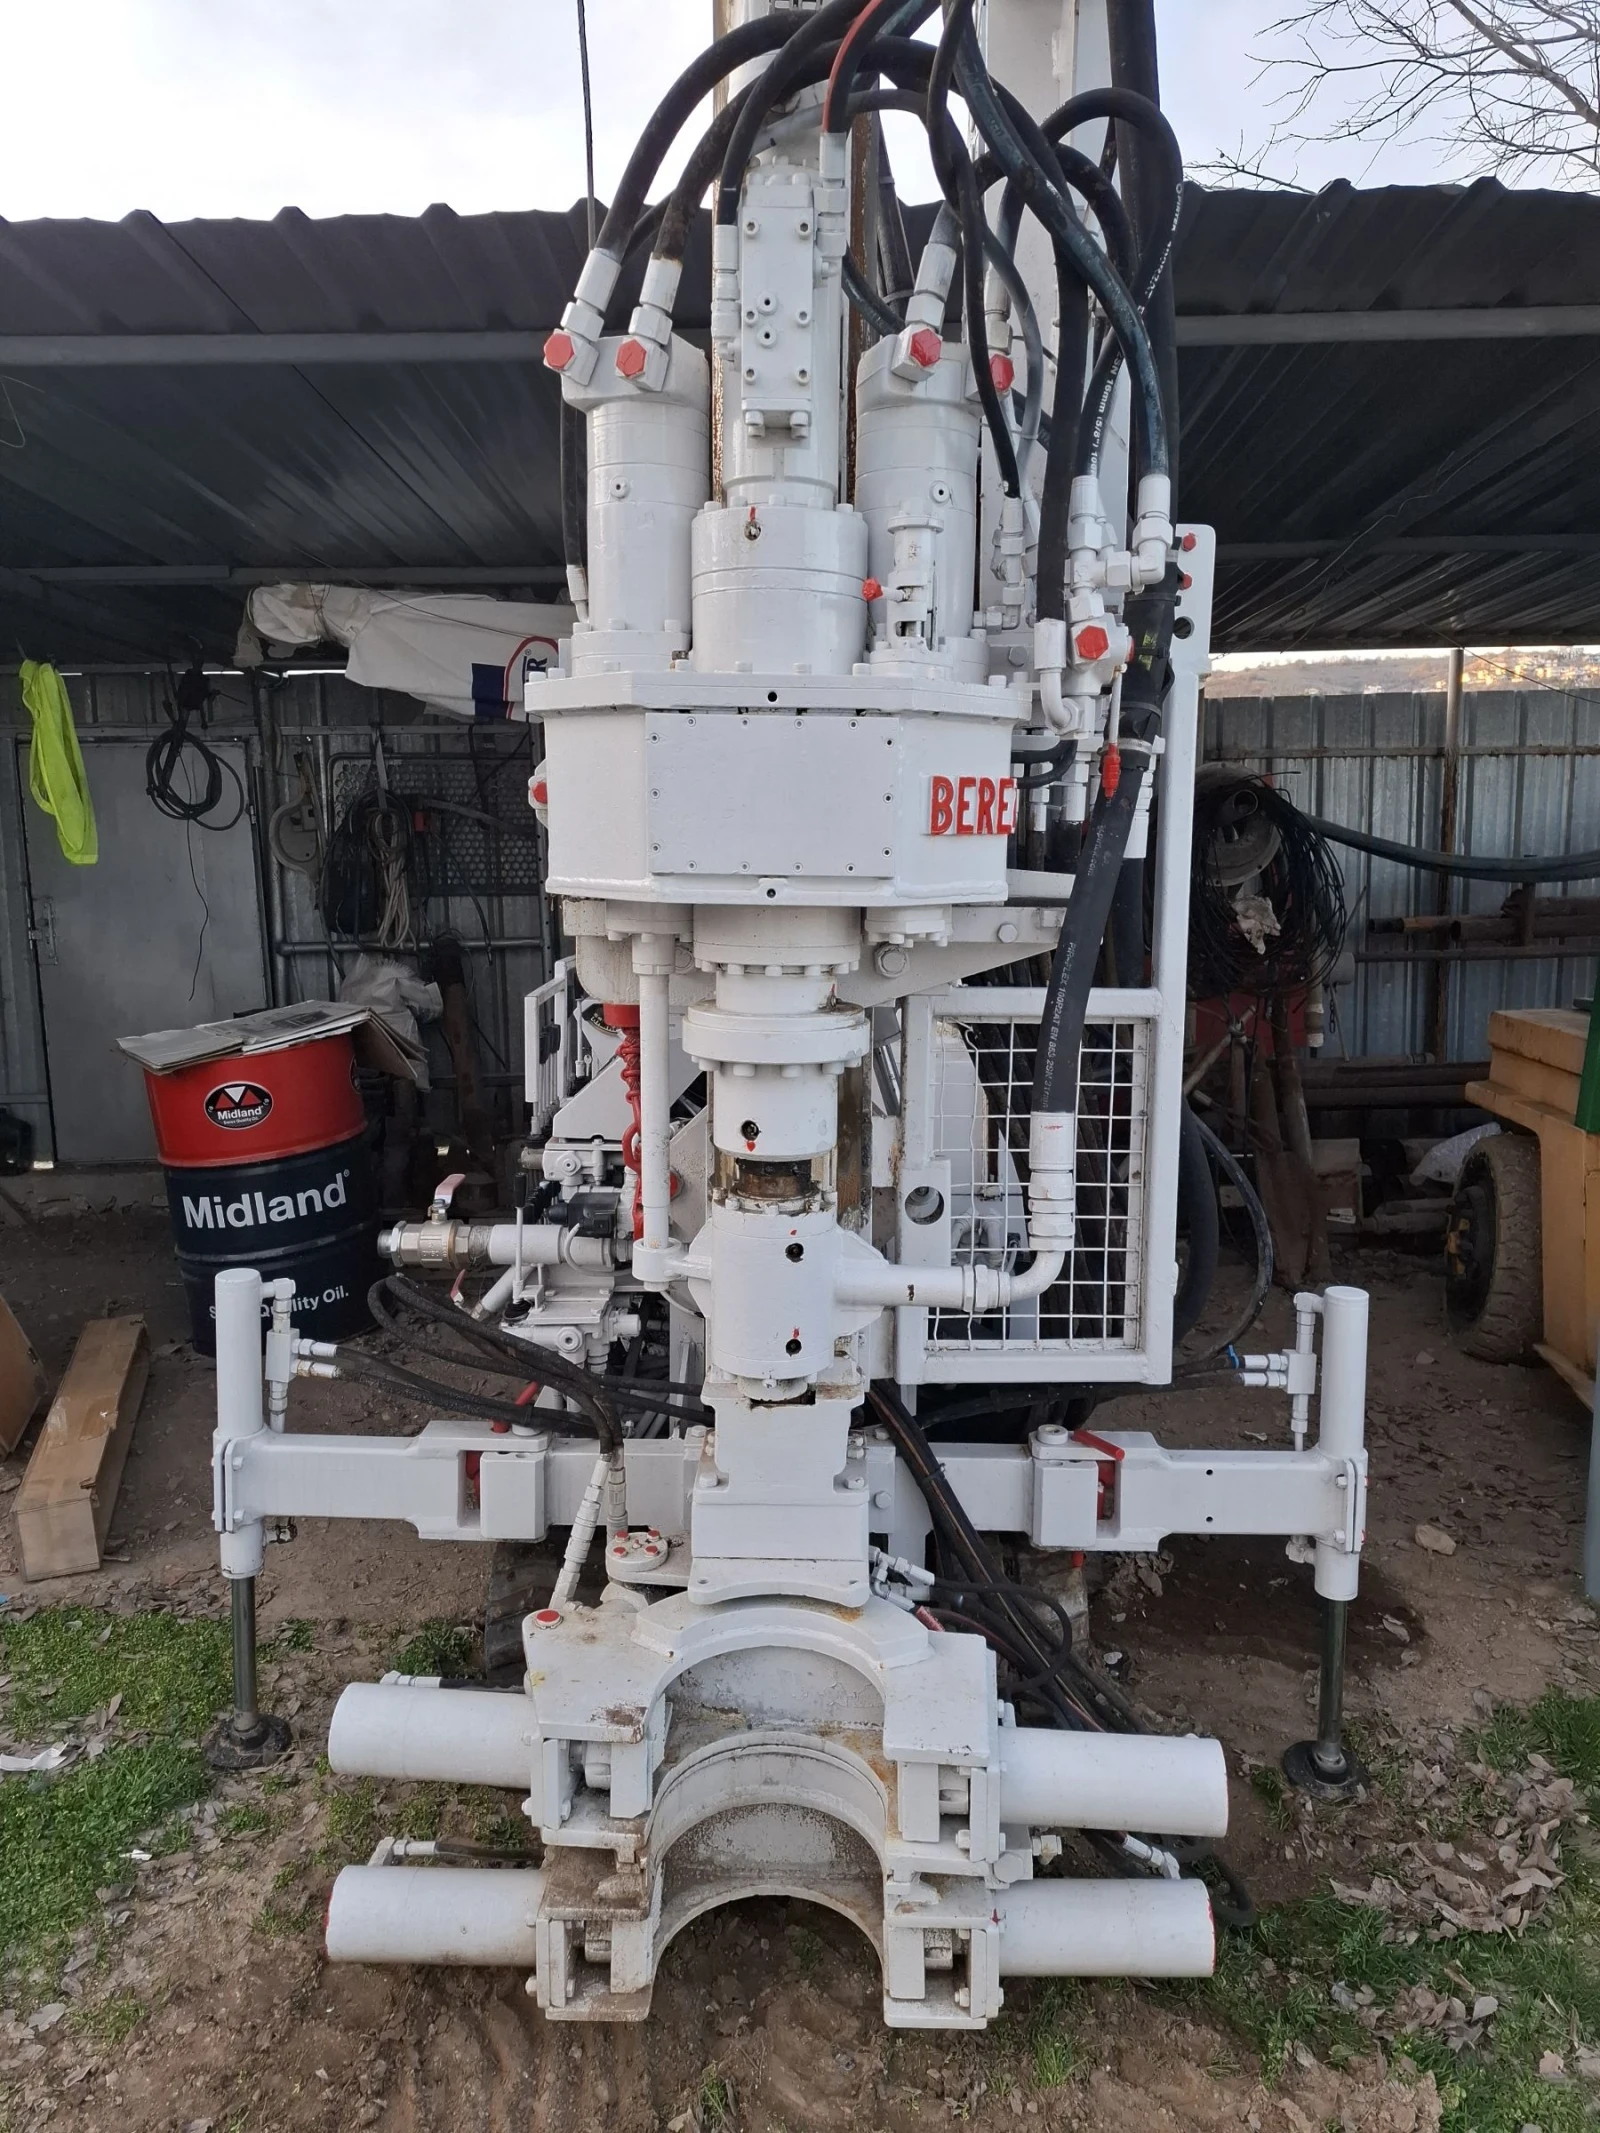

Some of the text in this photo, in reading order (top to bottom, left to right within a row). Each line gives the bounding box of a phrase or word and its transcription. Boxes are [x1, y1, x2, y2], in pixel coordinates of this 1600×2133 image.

[1098, 379, 1114, 413] 16mm
[930, 775, 1018, 836] BERE
[1050, 1026, 1059, 1040] EN
[217, 1106, 262, 1120] Midland
[182, 1172, 347, 1229] Midland
[260, 1285, 349, 1318] Qlity Oil.
